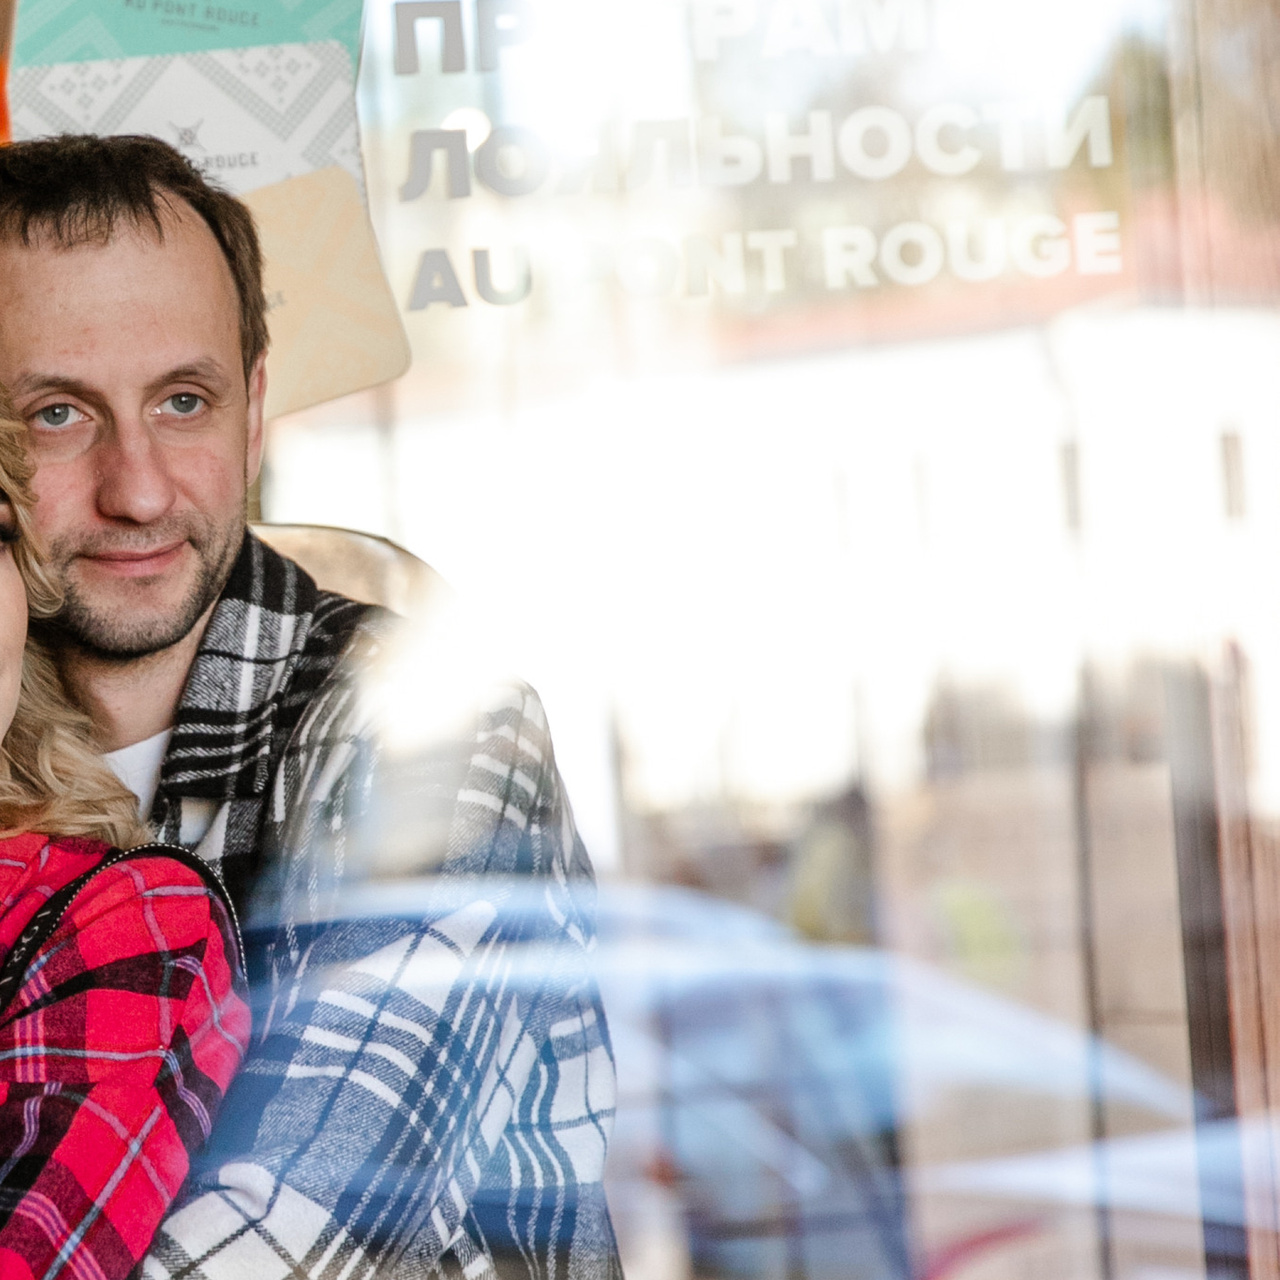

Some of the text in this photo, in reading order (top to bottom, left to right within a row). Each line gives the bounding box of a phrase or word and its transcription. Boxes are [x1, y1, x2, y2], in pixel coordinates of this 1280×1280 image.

[398, 94, 1114, 202] ЛОЛЬНОСТИ
[407, 243, 533, 311] AU
[823, 211, 1123, 293] ROUGE
